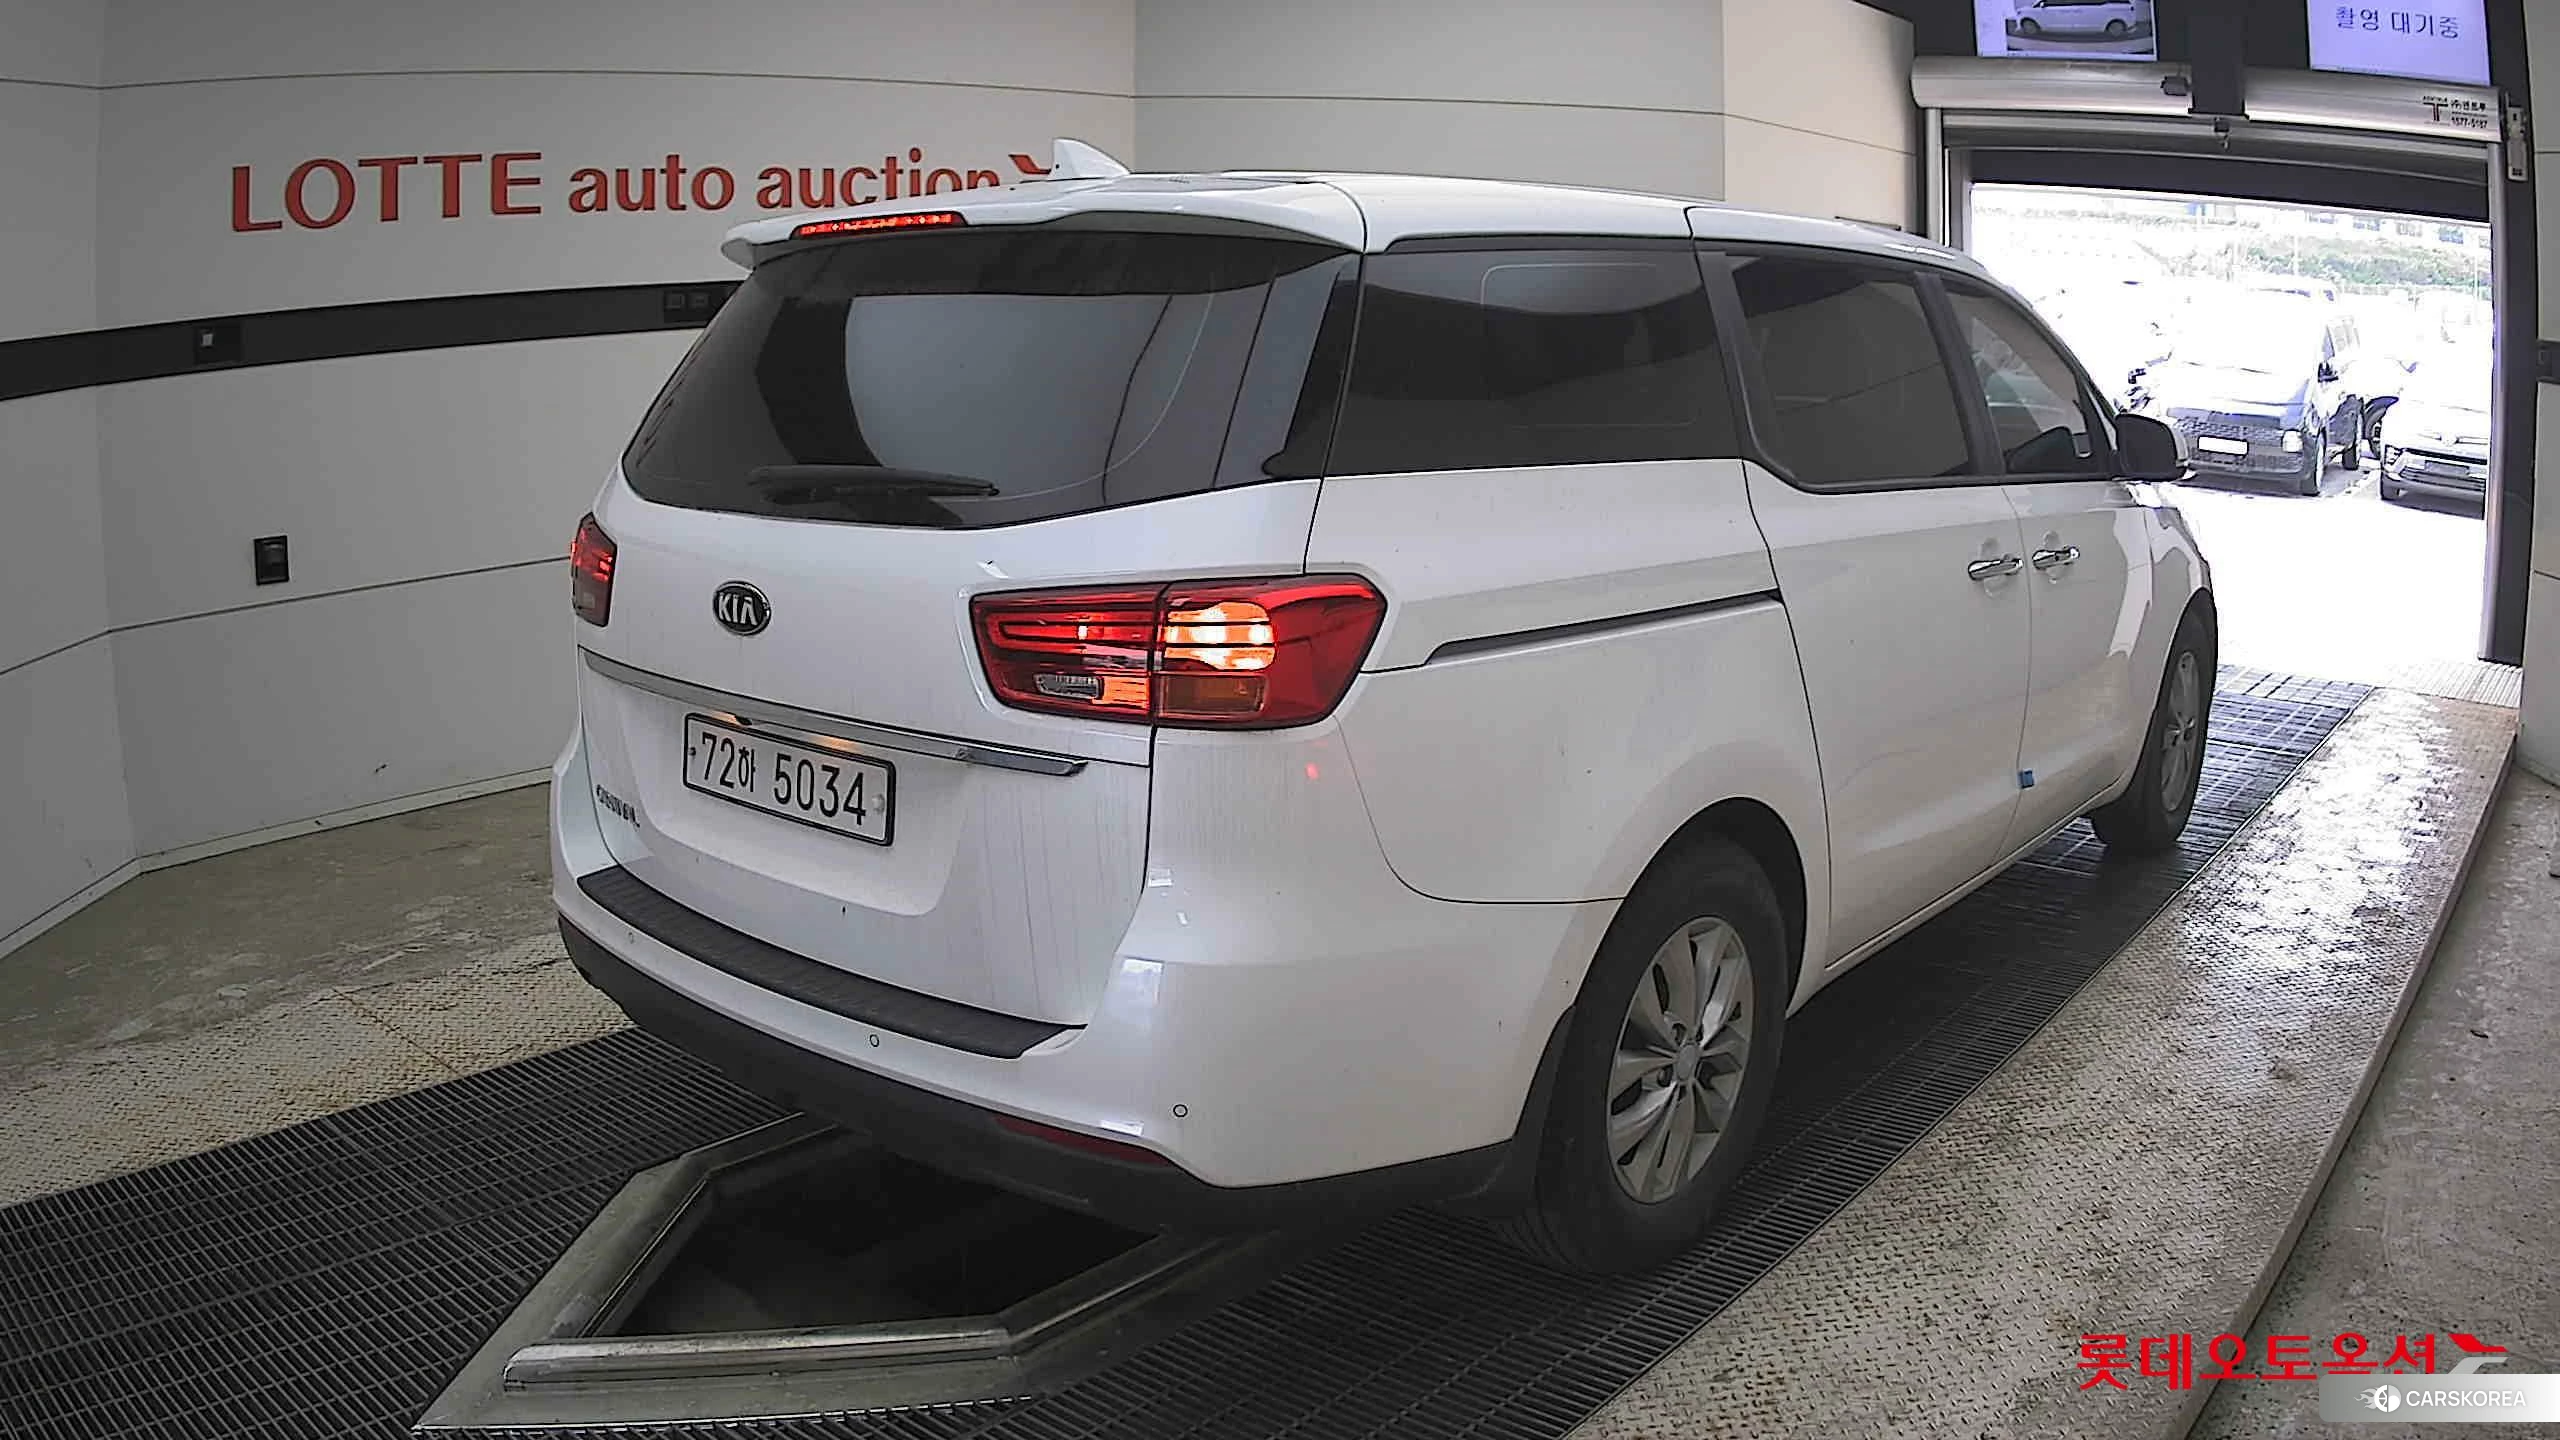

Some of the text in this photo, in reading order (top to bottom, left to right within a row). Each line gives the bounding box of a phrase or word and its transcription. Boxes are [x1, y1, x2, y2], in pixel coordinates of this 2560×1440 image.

[2391, 12, 2459, 39] 대기중
[231, 151, 542, 232] LOTTE
[567, 153, 736, 214] auto
[718, 592, 758, 626] KIA
[702, 731, 867, 826] 72하 5034
